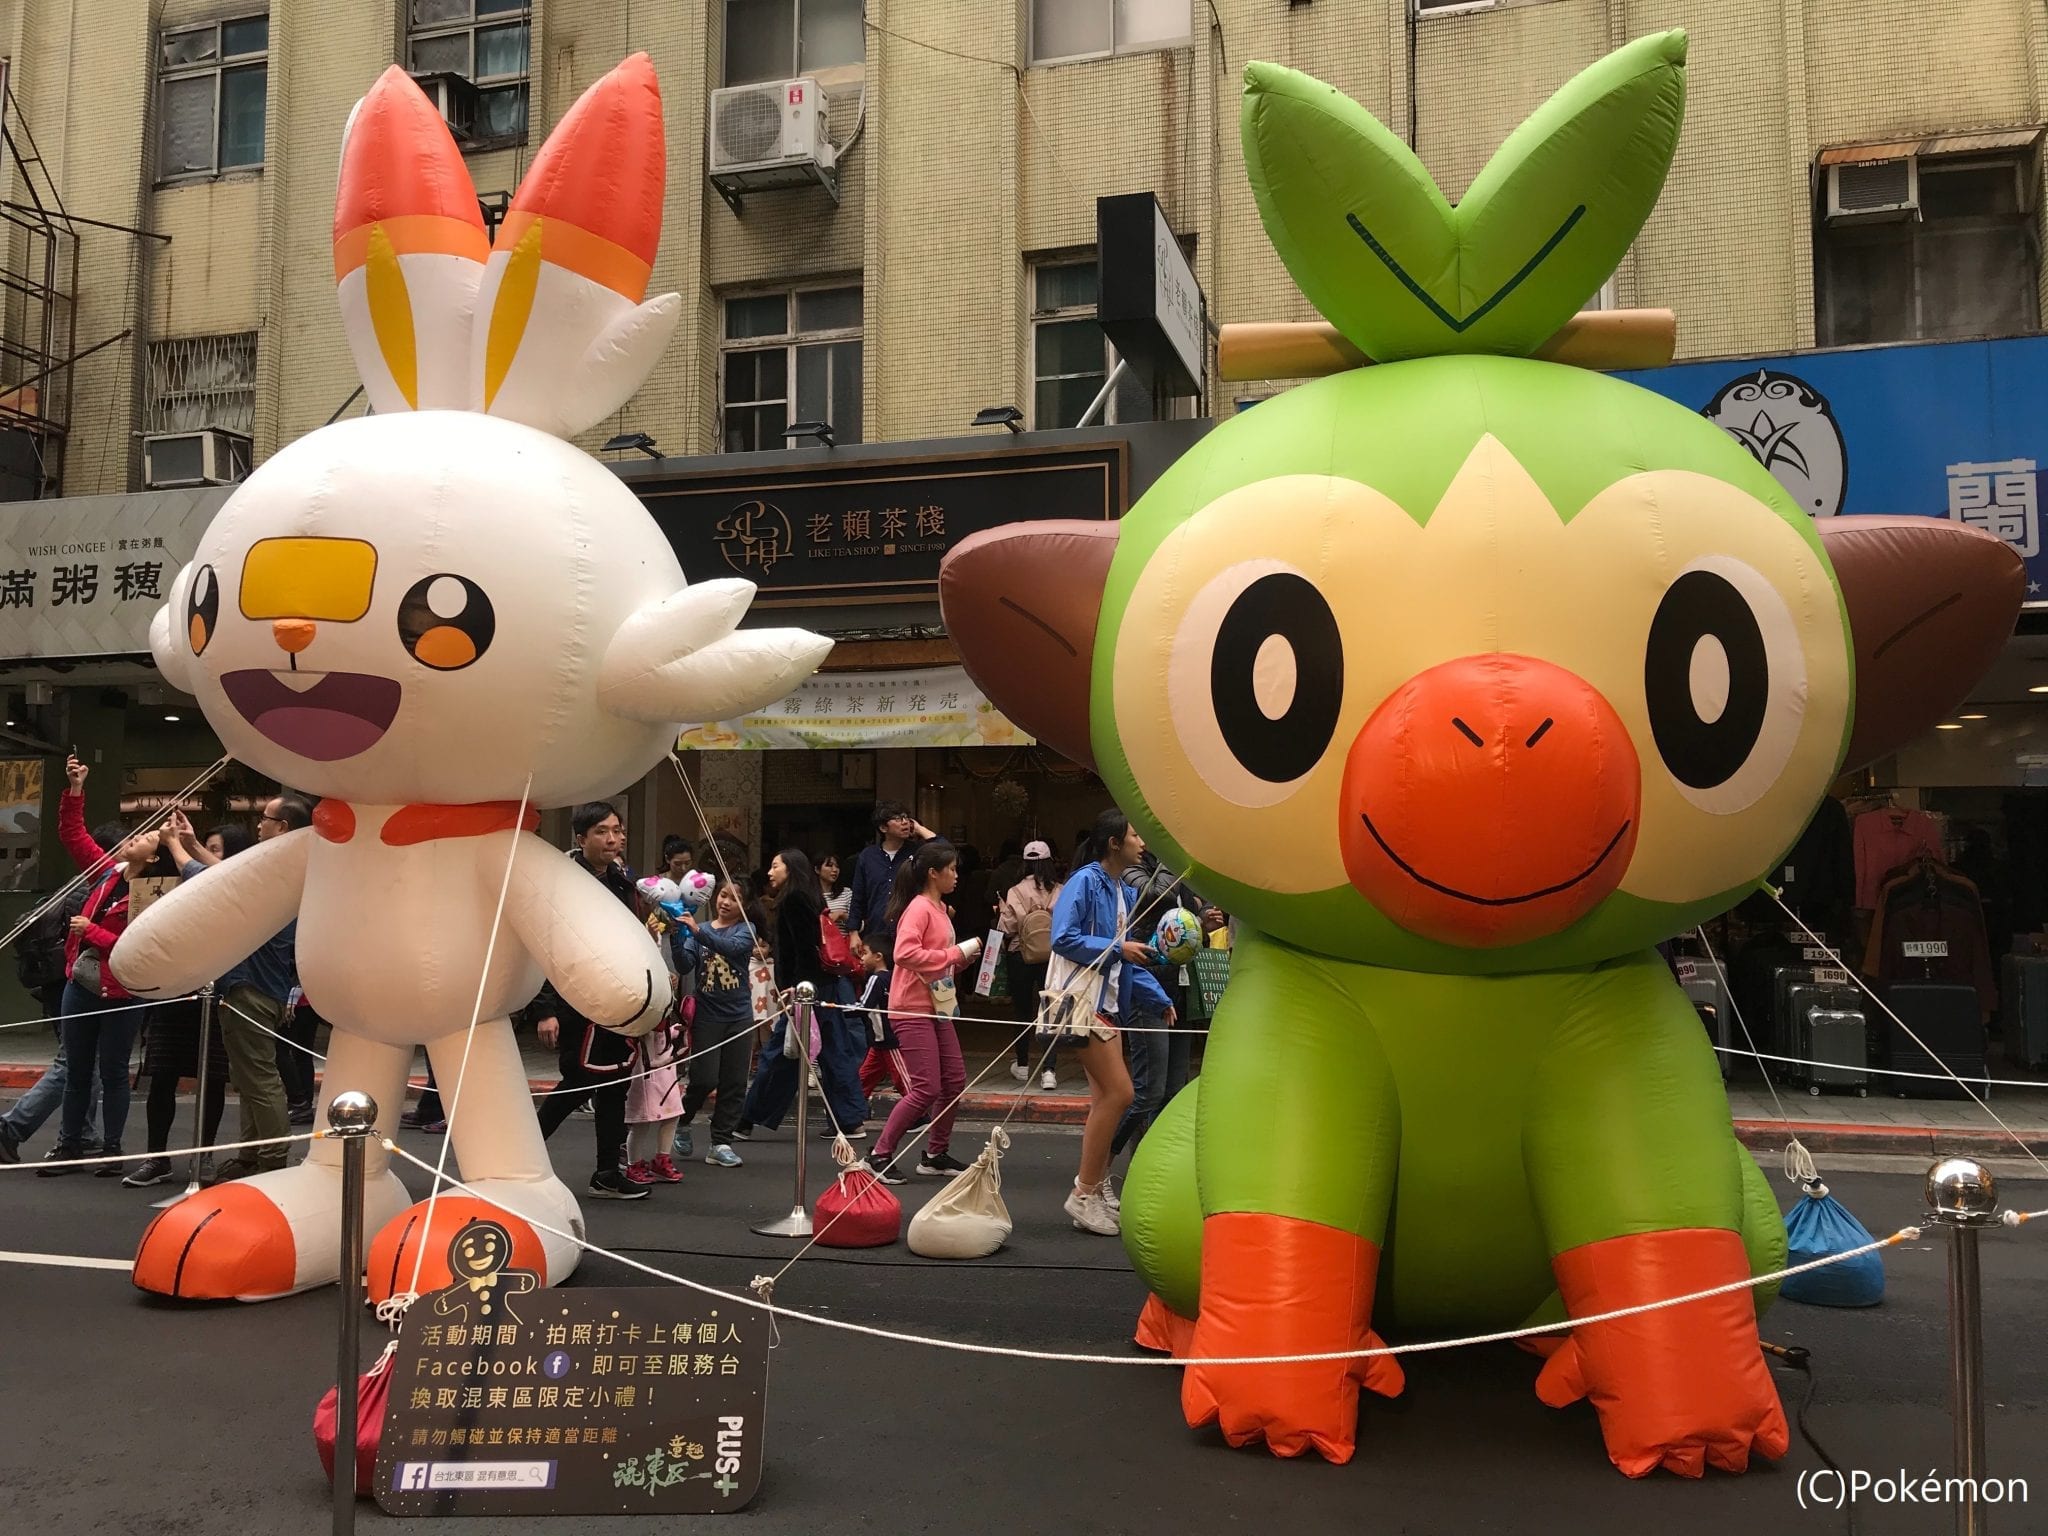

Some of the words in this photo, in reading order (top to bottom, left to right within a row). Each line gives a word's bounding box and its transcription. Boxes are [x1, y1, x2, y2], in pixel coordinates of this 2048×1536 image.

[805, 505, 946, 542] 老賴茶棧
[28, 544, 57, 557] WISH
[61, 541, 106, 554] CONGEE
[808, 548, 831, 558] LIKE
[832, 547, 852, 557] TEA
[854, 545, 880, 556] SHOP
[900, 543, 926, 553] SINCE
[927, 542, 946, 552] 1980
[1919, 942, 1947, 954] 1990
[1822, 970, 1846, 981] 1690
[416, 1355, 538, 1376] Facebook
[411, 1426, 619, 1445] 請勿觸碰並保持適當距離
